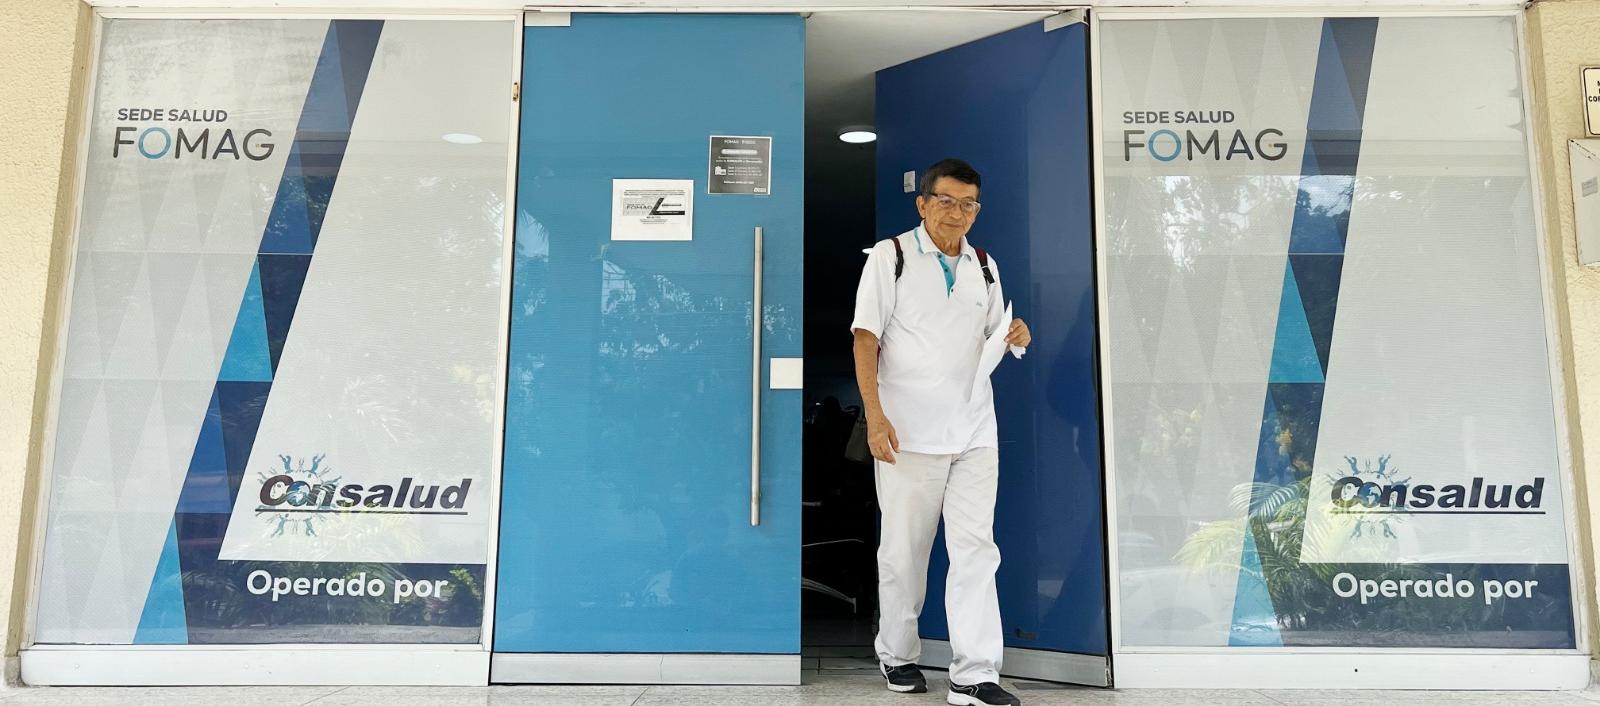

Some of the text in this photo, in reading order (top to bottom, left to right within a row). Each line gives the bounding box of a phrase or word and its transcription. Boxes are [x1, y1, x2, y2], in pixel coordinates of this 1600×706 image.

[117, 108, 228, 122] SEDE SALUD
[1123, 110, 1235, 124] SEDE SALUD
[112, 126, 275, 161] FOMAG
[1123, 128, 1288, 162] FOMAG
[259, 474, 472, 509] Consalud
[1331, 476, 1545, 508] Consalud
[246, 569, 449, 603] Operado por
[1332, 572, 1538, 605] Operado por
